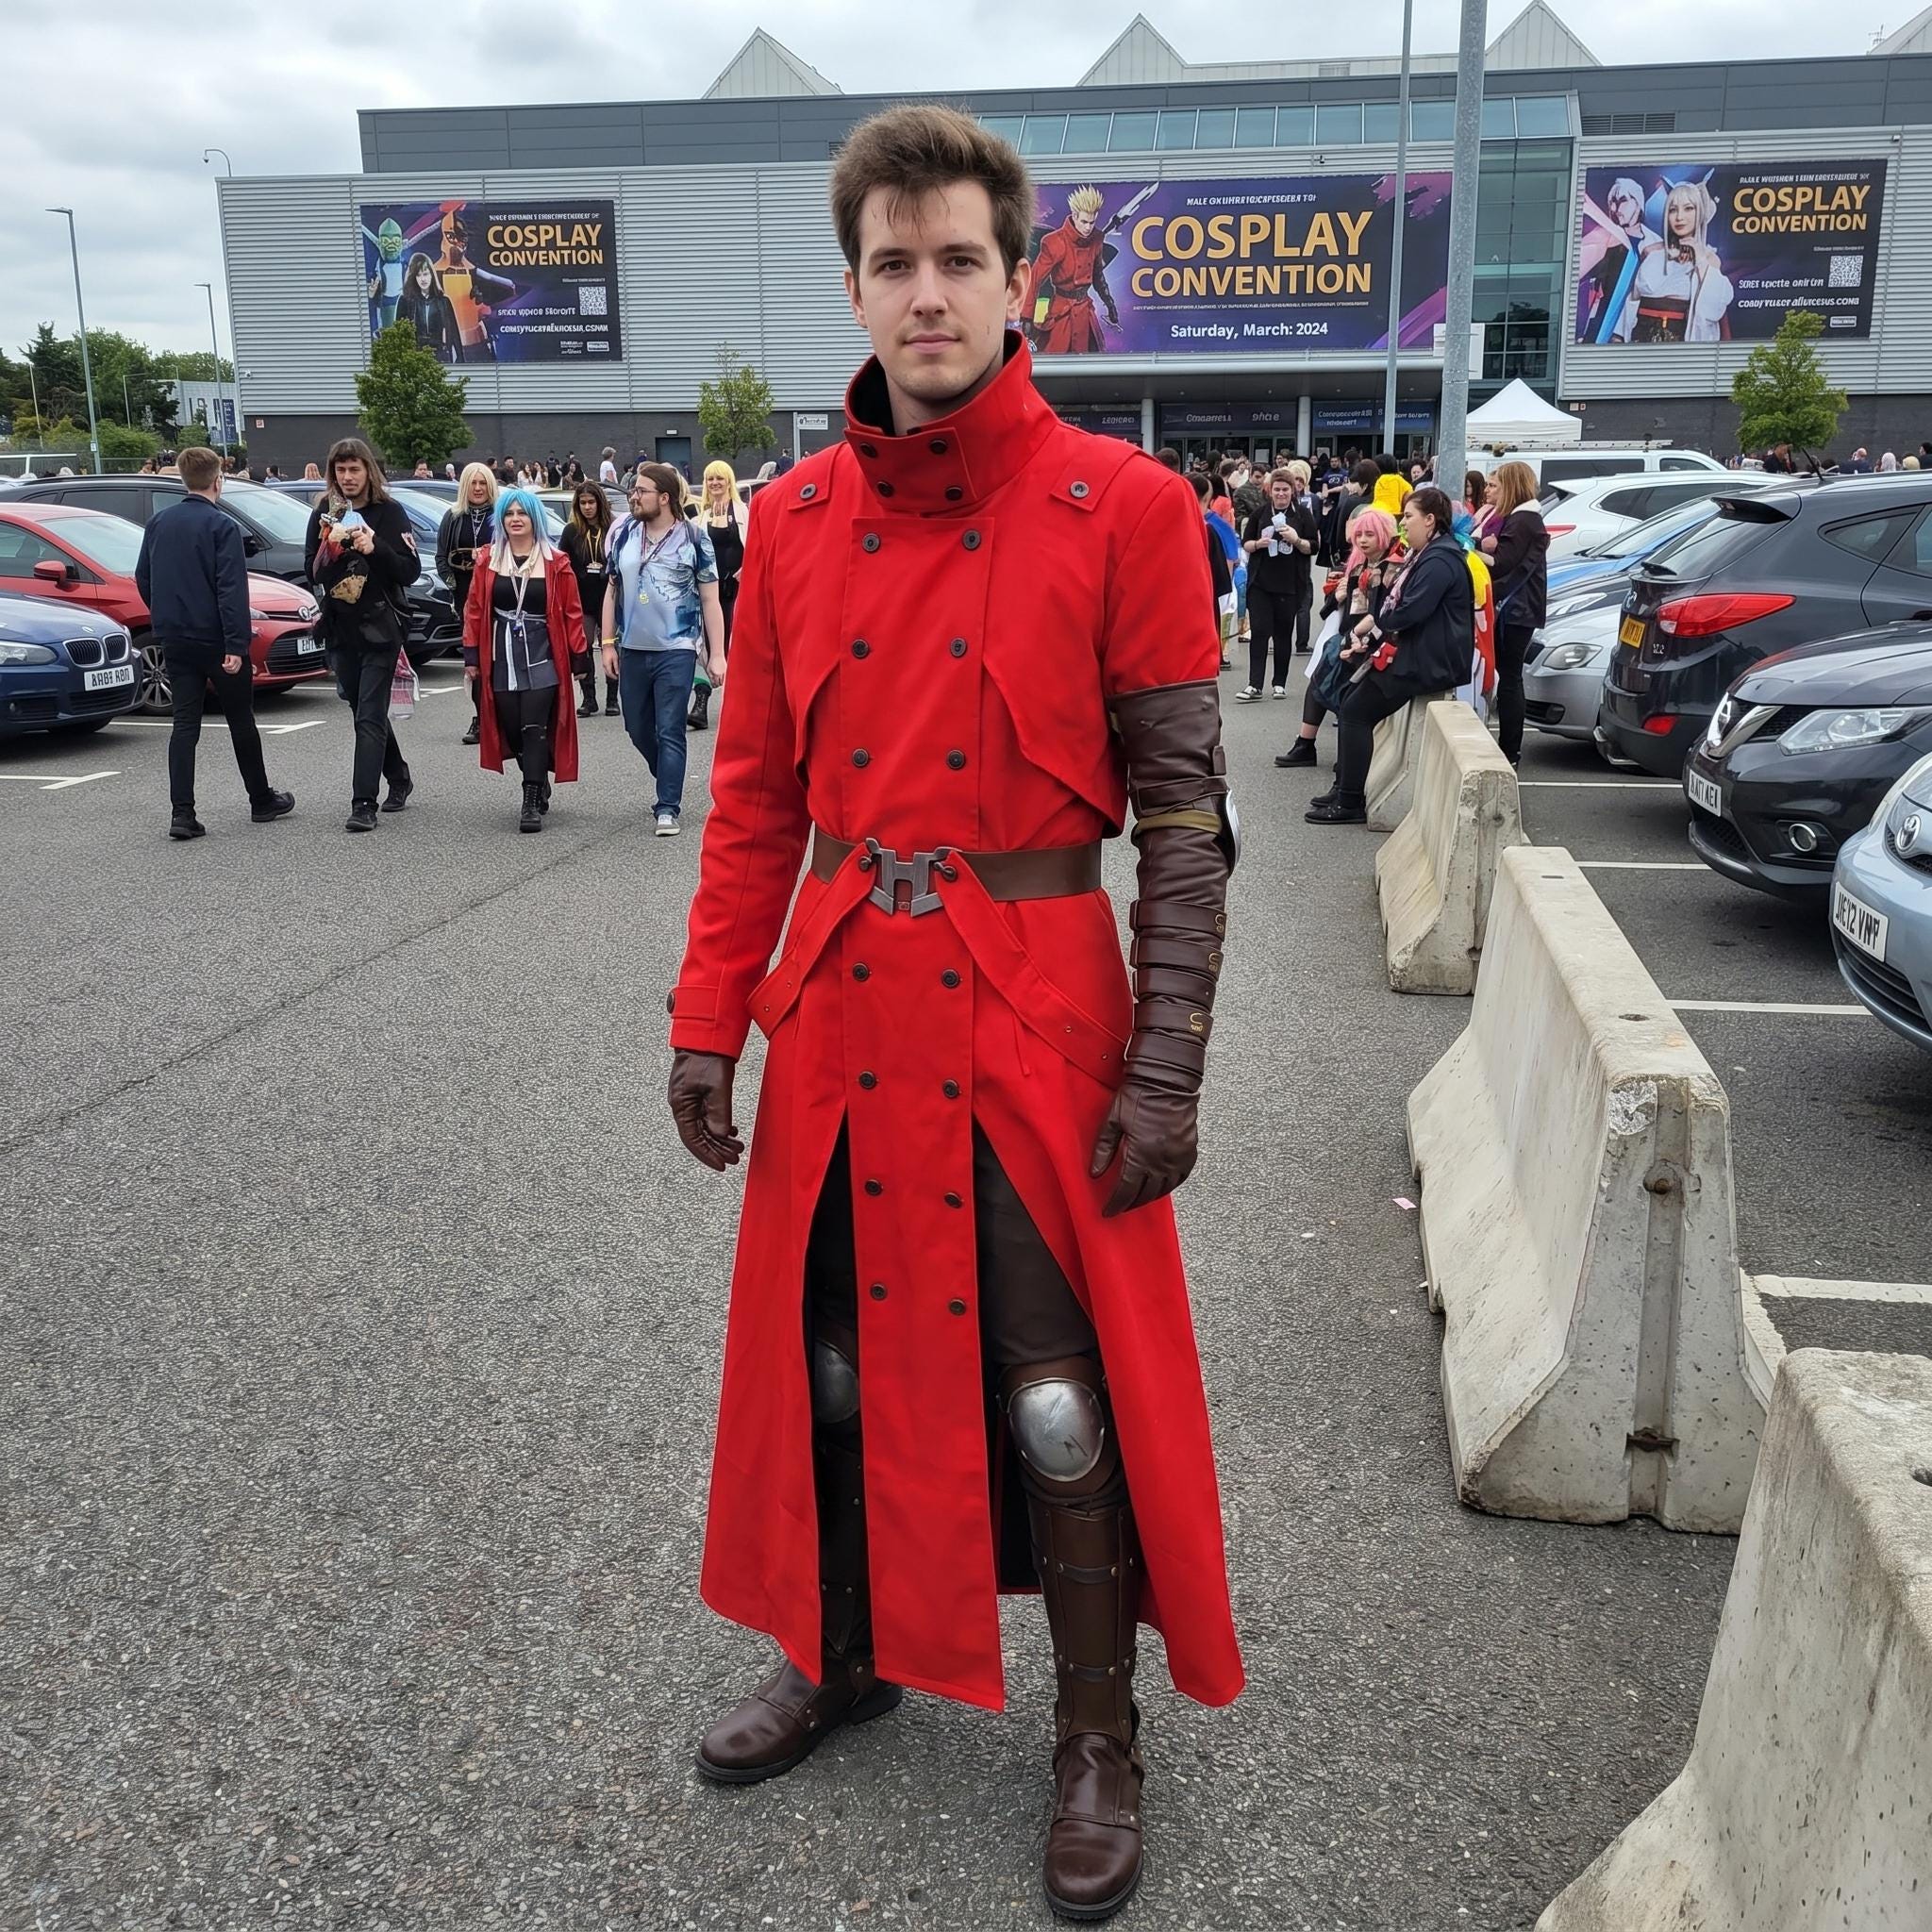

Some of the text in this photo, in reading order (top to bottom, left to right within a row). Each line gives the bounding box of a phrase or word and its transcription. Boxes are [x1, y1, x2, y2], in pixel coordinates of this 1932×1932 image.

[1734, 185, 1871, 213] COSPLAY
[1732, 213, 1868, 234] CONVENTION
[488, 224, 602, 247] COSPLAY
[1132, 211, 1374, 260] COSPLAY
[489, 249, 604, 266] CONVENTION
[1132, 262, 1372, 297] CONVENTION
[1171, 322, 1328, 340] Saturday, March: 2024
